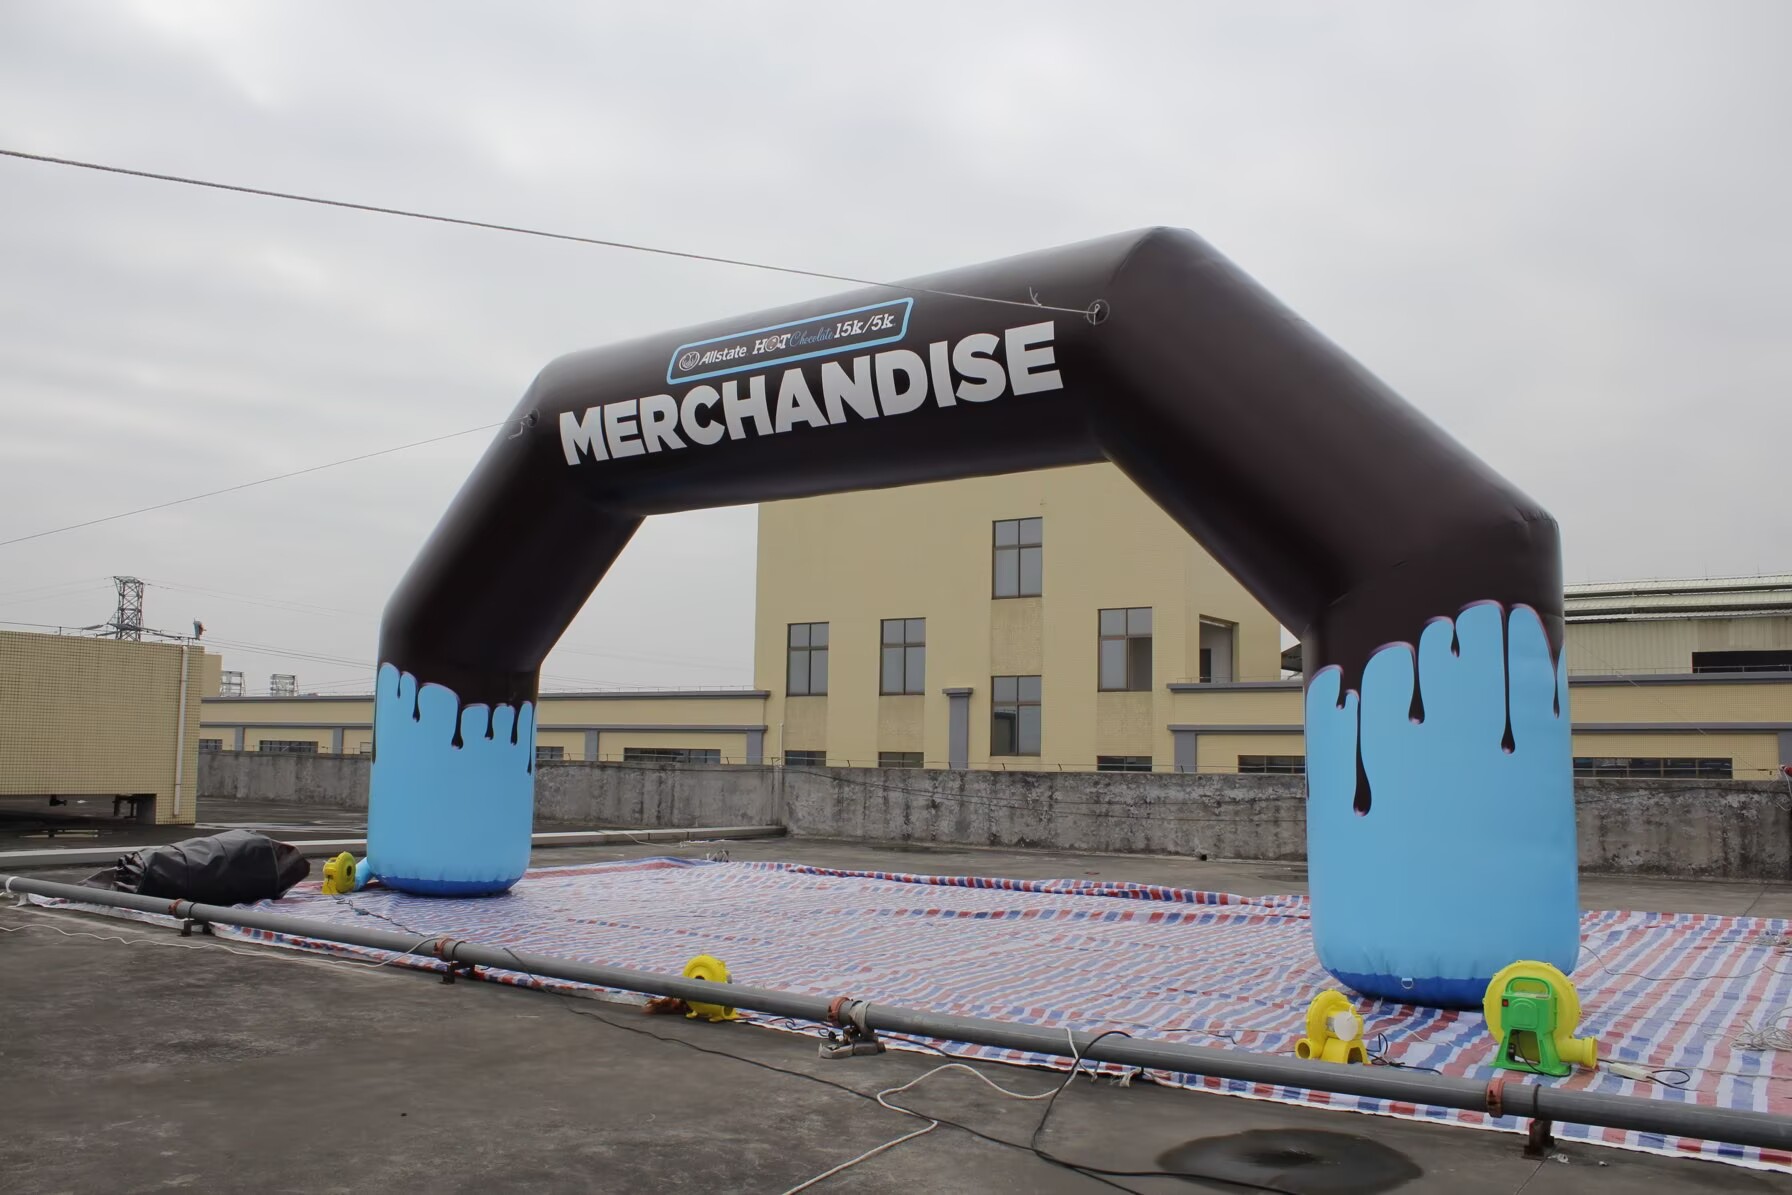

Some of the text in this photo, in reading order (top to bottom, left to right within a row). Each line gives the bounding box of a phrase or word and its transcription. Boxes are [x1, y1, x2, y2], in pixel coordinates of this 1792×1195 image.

[698, 346, 747, 366] Allstate
[789, 327, 834, 347] Chocolate
[833, 313, 895, 339] 15k/5k
[559, 320, 1064, 466] MERCHANDISE
